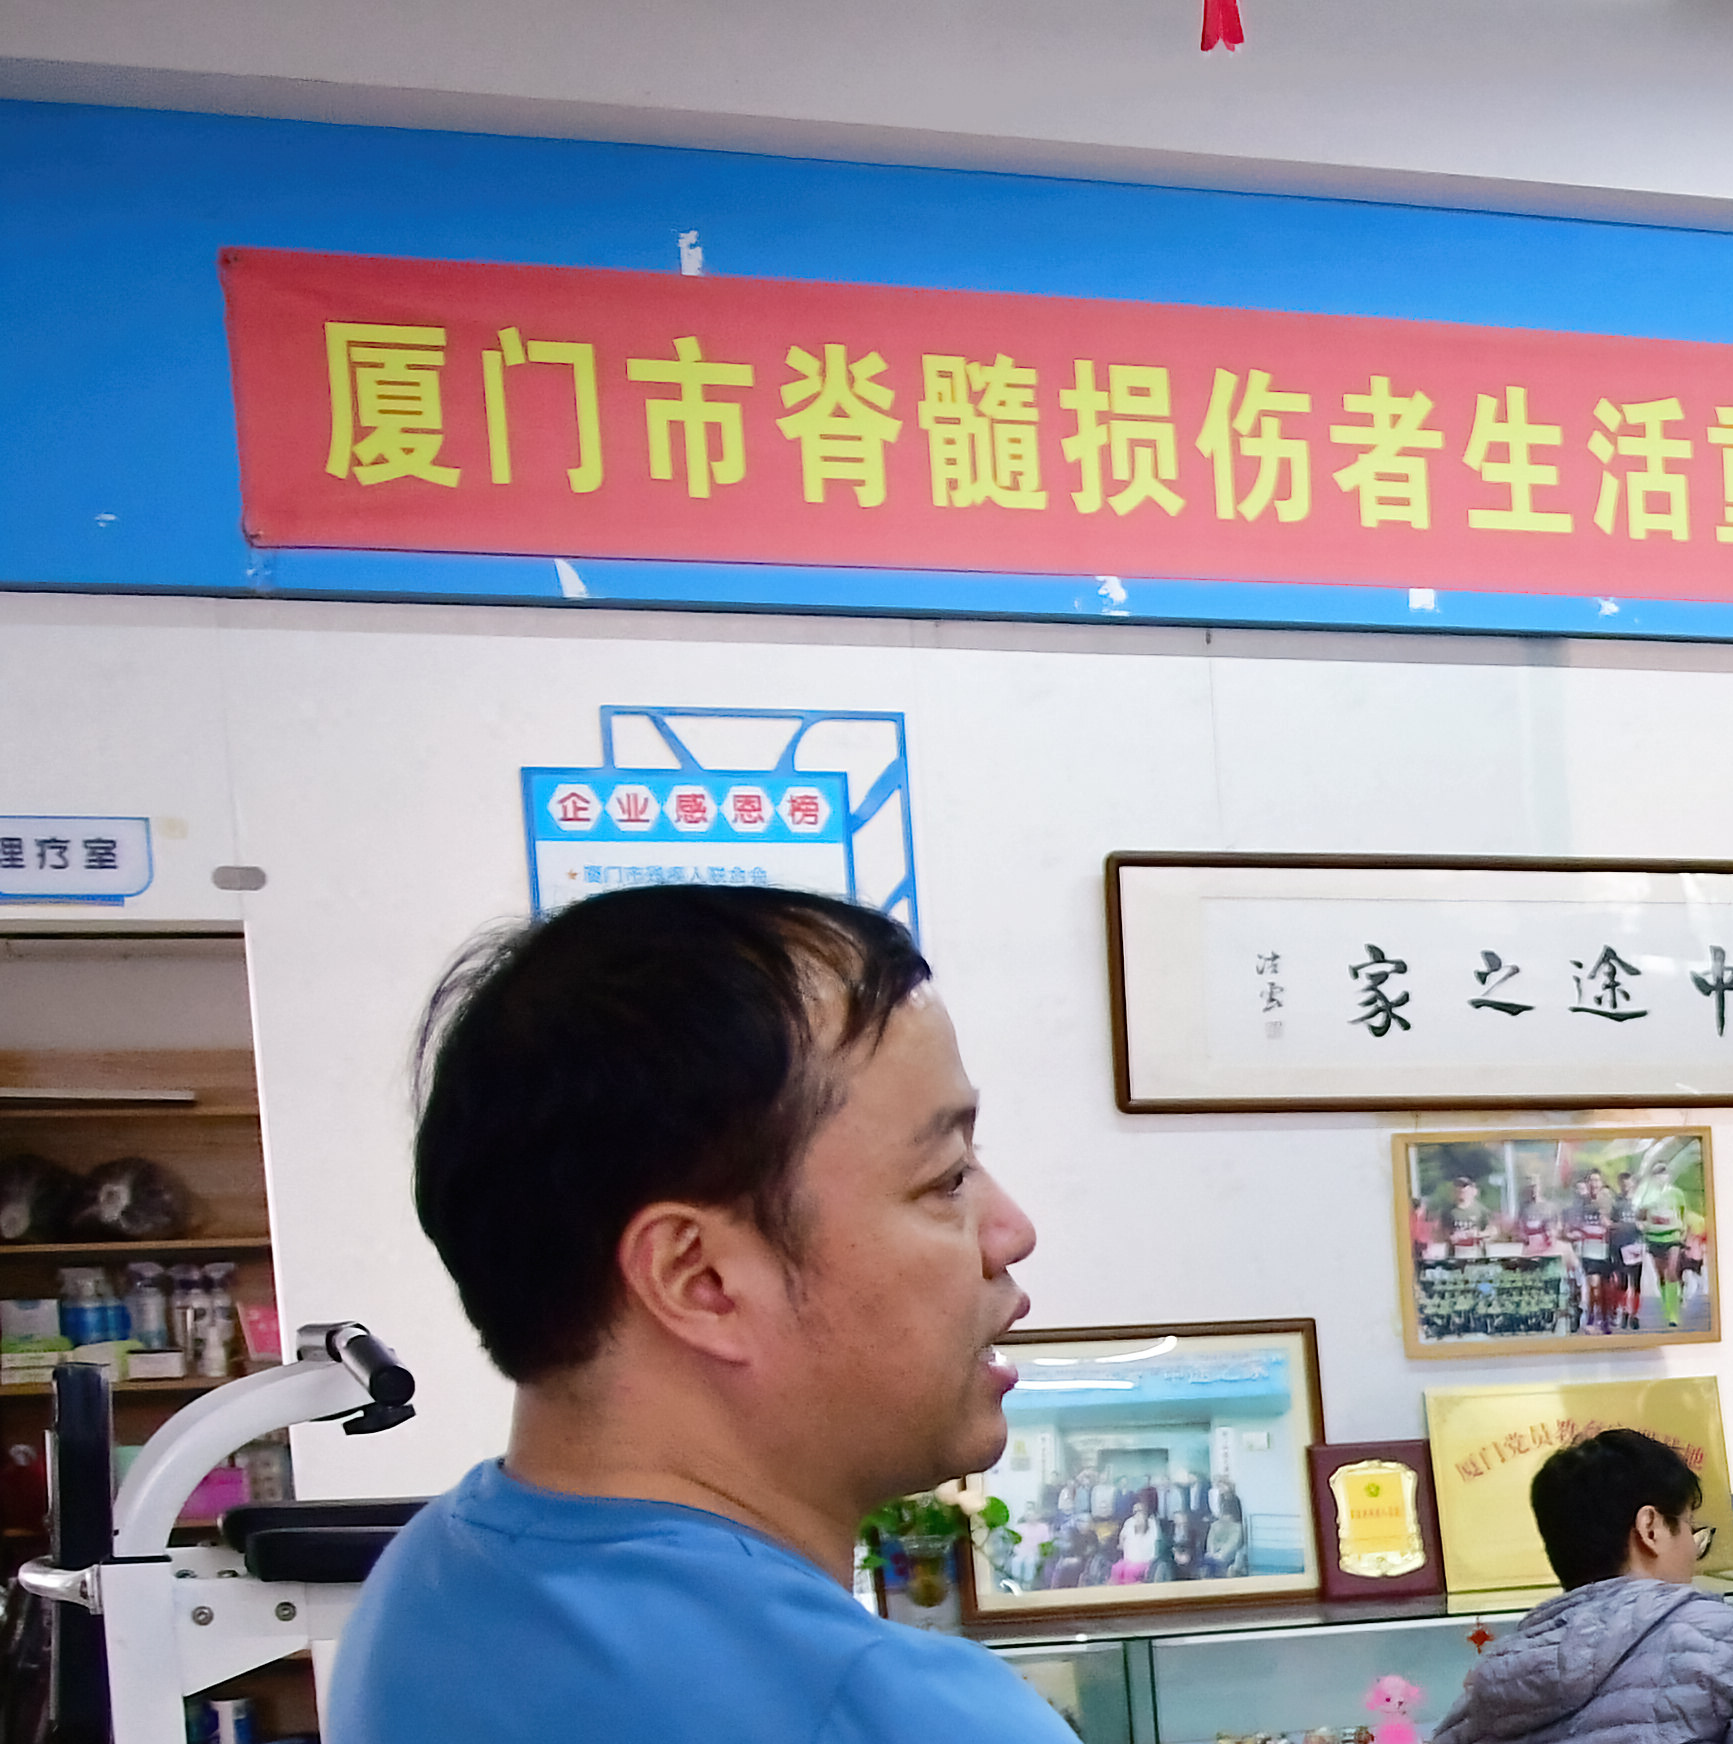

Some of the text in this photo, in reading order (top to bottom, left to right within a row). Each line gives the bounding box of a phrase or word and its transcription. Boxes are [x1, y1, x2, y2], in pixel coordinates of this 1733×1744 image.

[557, 791, 820, 826] 企业感恩榜
